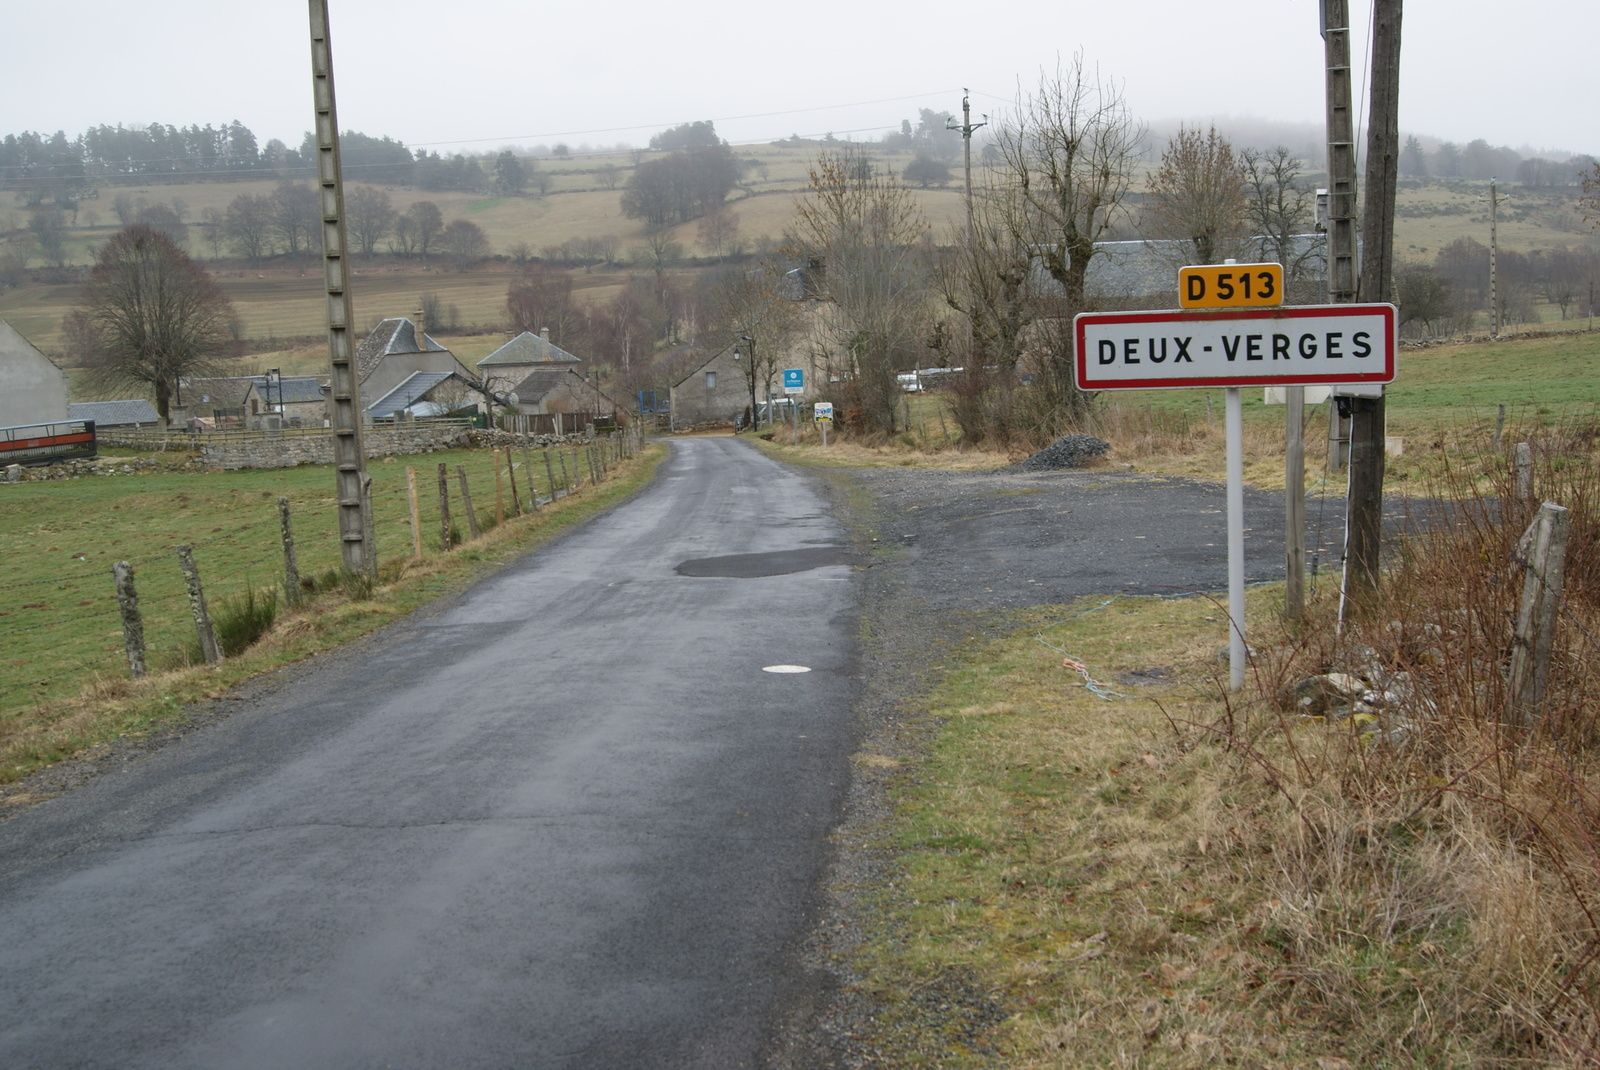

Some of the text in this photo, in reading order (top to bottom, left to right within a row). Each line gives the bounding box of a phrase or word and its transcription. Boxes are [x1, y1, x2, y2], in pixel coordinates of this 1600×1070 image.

[1187, 272, 1275, 301] D 513
[1098, 331, 1372, 365] DEUX-VERGES
